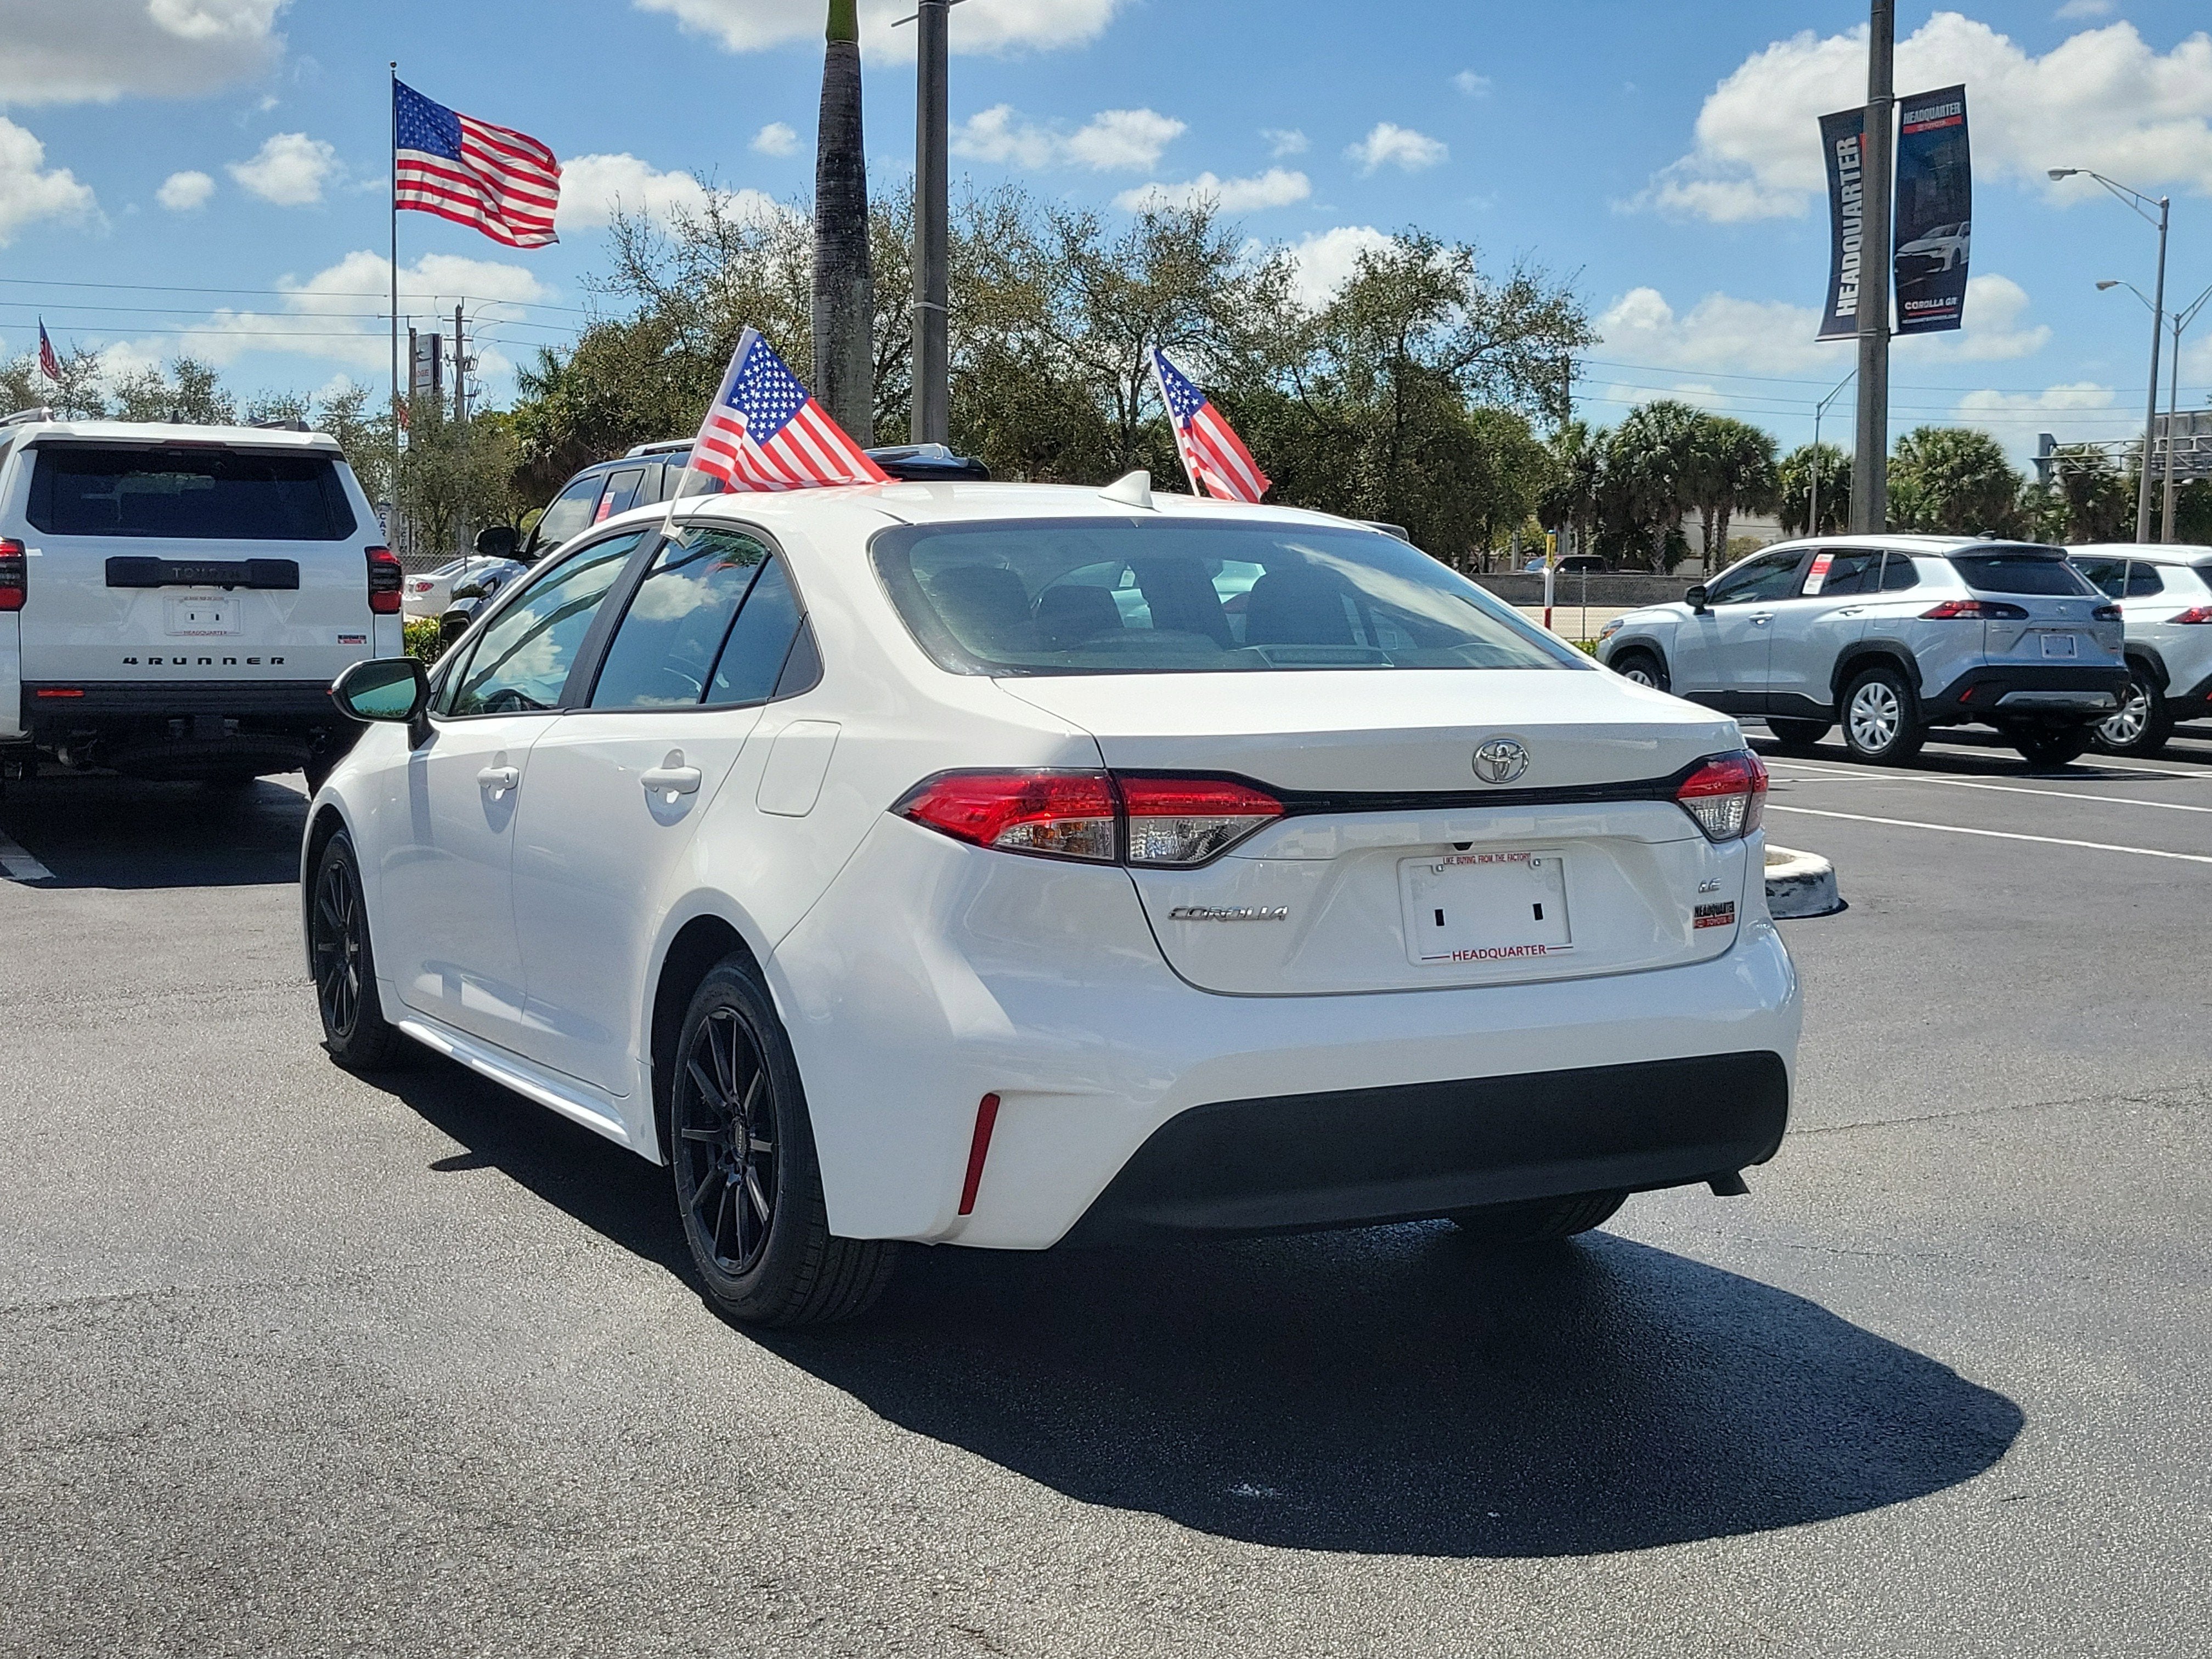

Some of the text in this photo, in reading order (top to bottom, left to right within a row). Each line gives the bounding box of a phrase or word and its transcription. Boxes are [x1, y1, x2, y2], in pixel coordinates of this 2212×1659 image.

[1903, 102, 1961, 125] HEADQUARTER
[1835, 137, 1863, 317] HEADQUARTER
[1904, 298, 1944, 310] COROLLA
[1457, 856, 1476, 864] BUYING
[1478, 855, 1493, 864] FROM
[1167, 906, 1288, 921] COROLLA
[1452, 945, 1547, 961] HEADQUARTER
